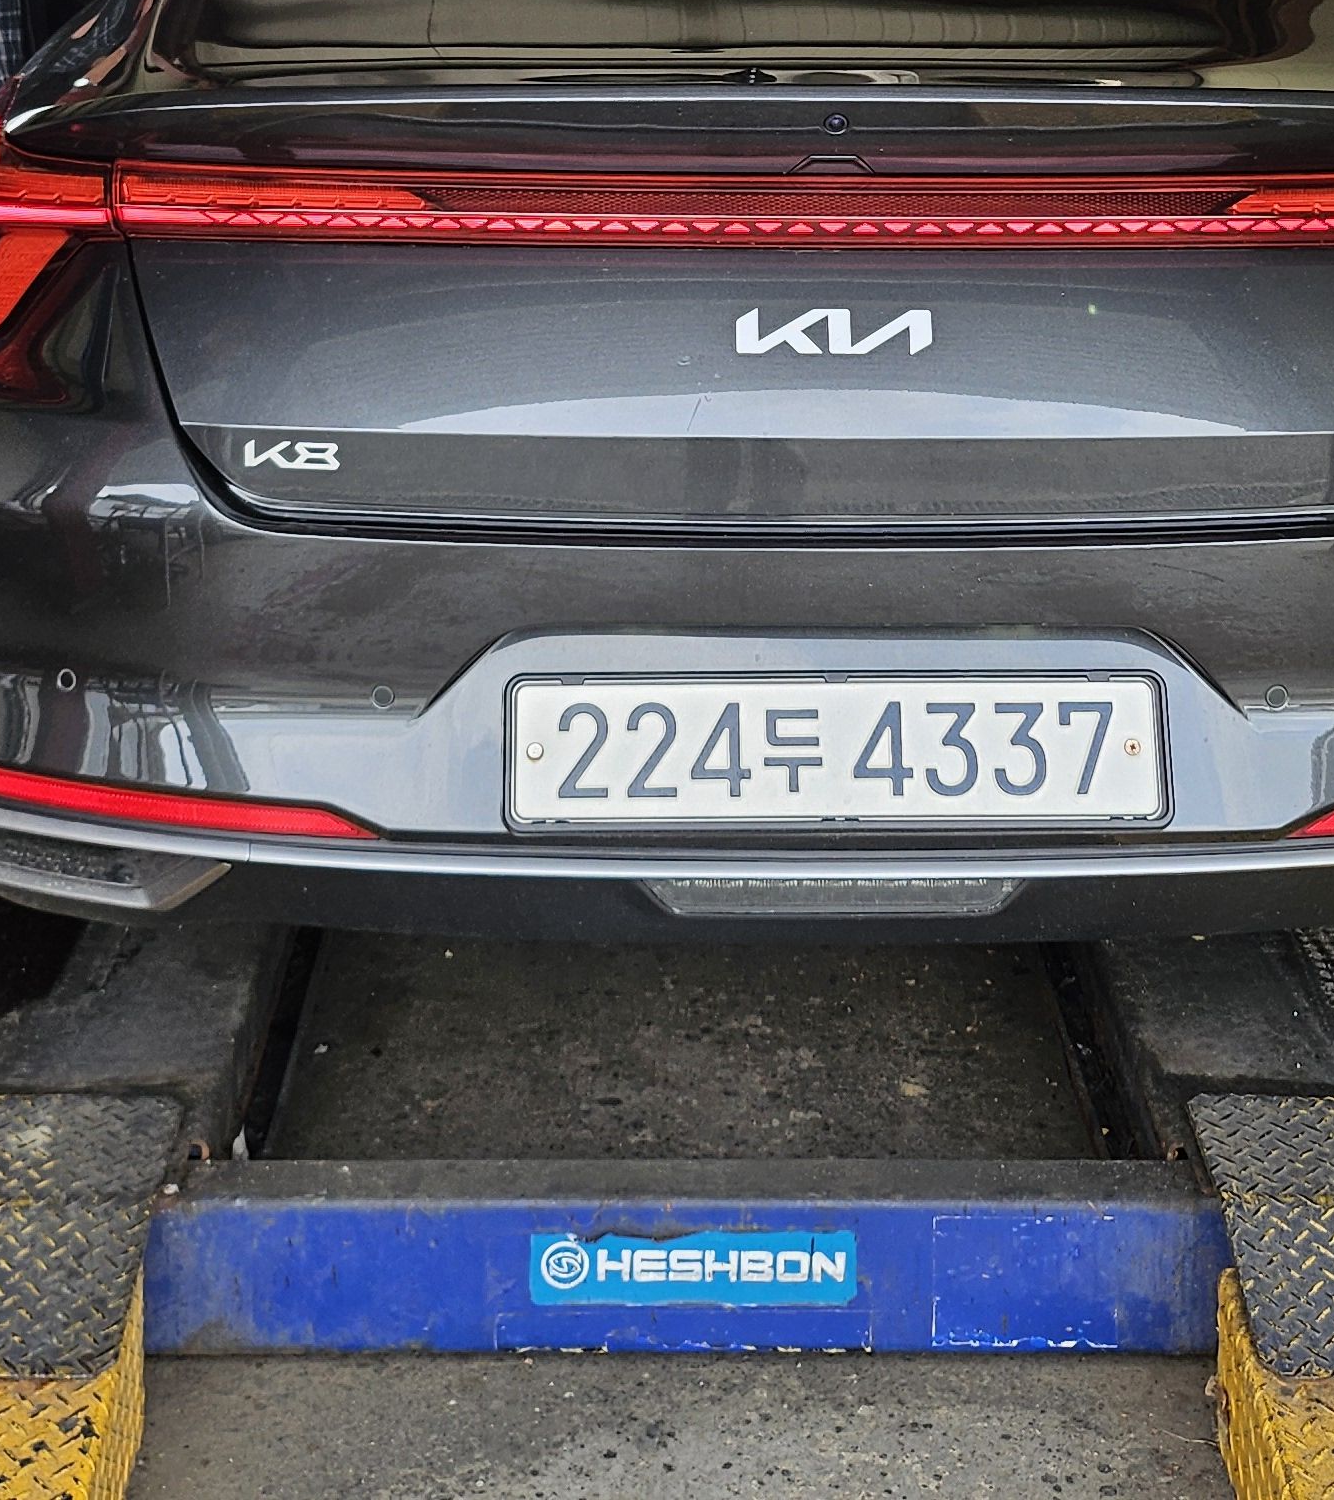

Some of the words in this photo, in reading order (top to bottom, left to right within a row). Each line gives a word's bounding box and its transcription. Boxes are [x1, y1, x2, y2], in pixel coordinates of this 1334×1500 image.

[735, 307, 933, 355] KIA
[244, 439, 341, 471] K8
[852, 700, 1114, 799] 4337
[596, 1248, 847, 1284] HESHBON
